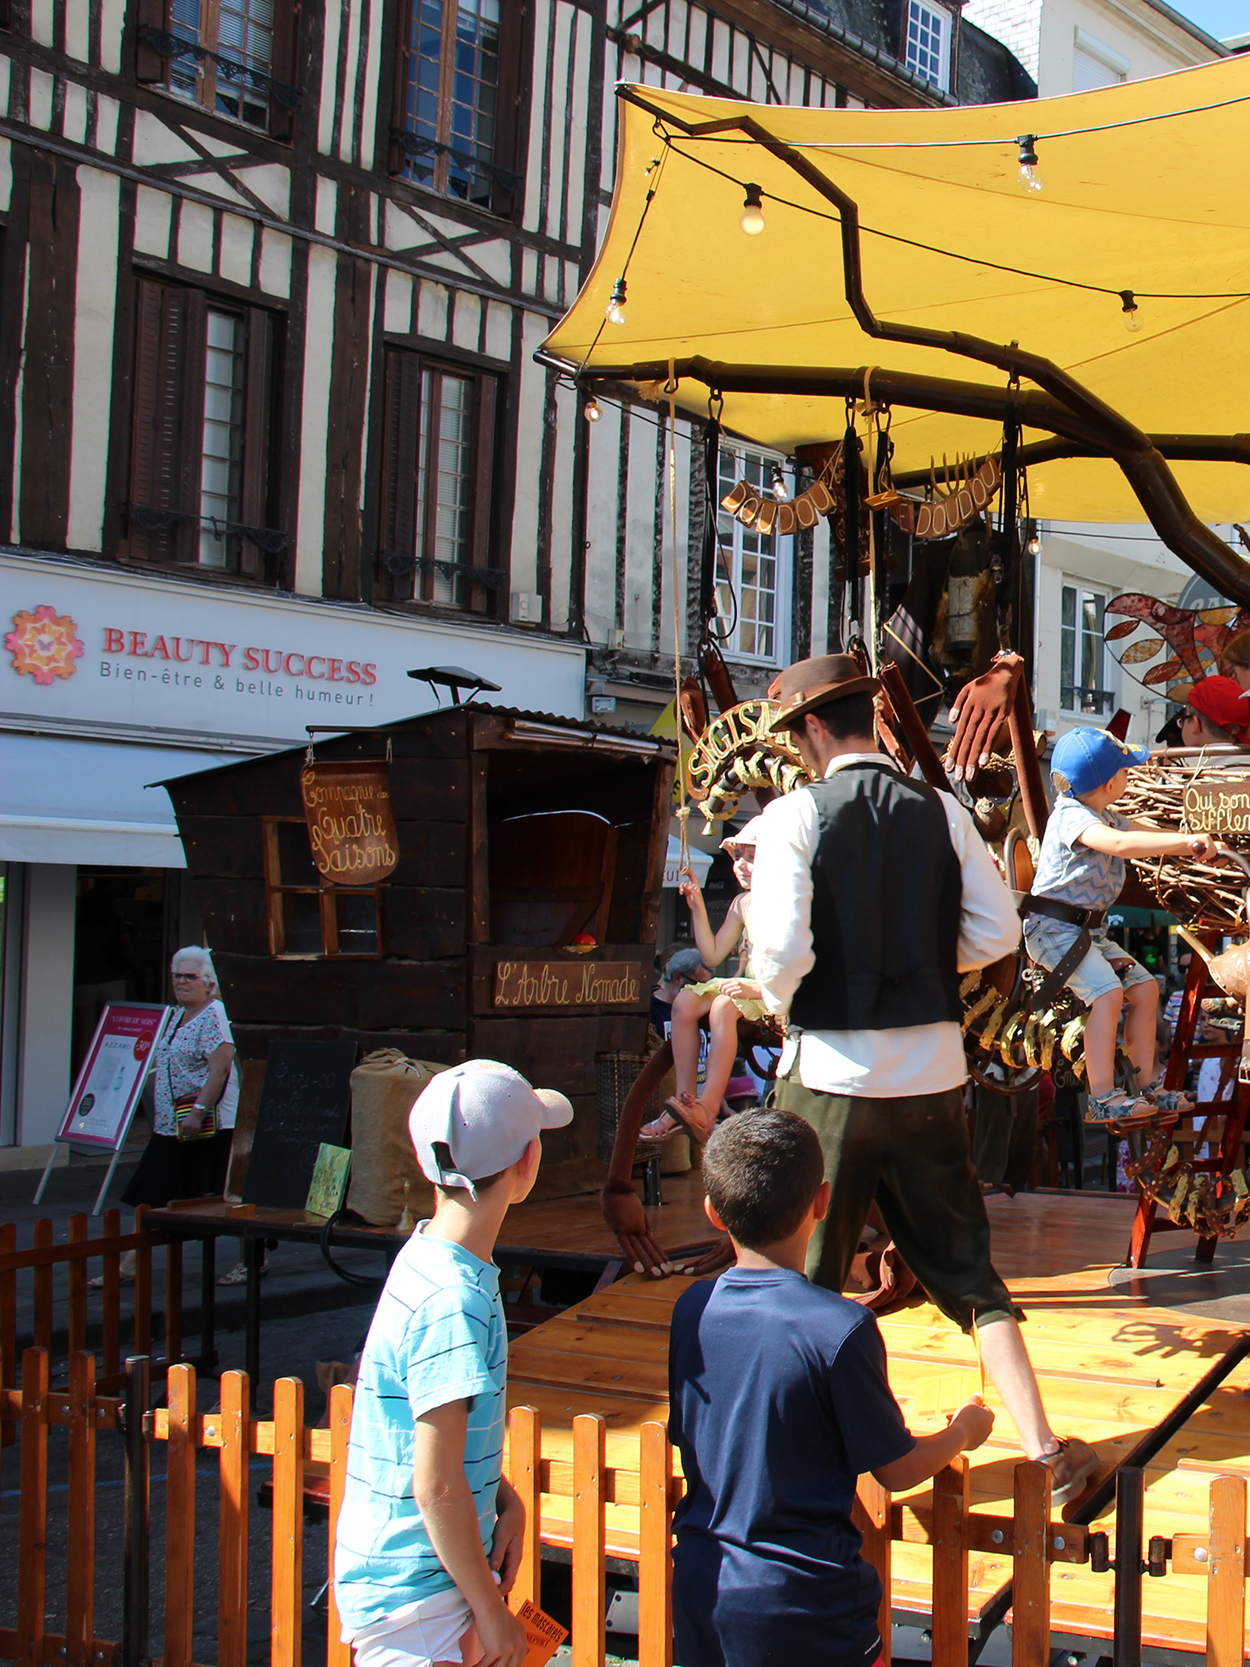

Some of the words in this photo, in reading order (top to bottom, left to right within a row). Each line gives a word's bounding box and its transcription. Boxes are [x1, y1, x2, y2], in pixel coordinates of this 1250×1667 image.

[724, 483, 830, 532] DOUDOU
[916, 461, 995, 536] DOUDOU
[102, 627, 237, 668] BEAUTY
[242, 646, 377, 686] SUCCESS
[100, 661, 203, 688] Bien-être
[213, 675, 225, 691] &
[236, 678, 285, 697] belle
[302, 769, 375, 813] Compagnie
[1185, 788, 1216, 813] Qui
[318, 804, 387, 845] Quatre
[311, 825, 396, 873] Saisons
[495, 962, 571, 1005] L'Arbre
[520, 1601, 535, 1620] les
